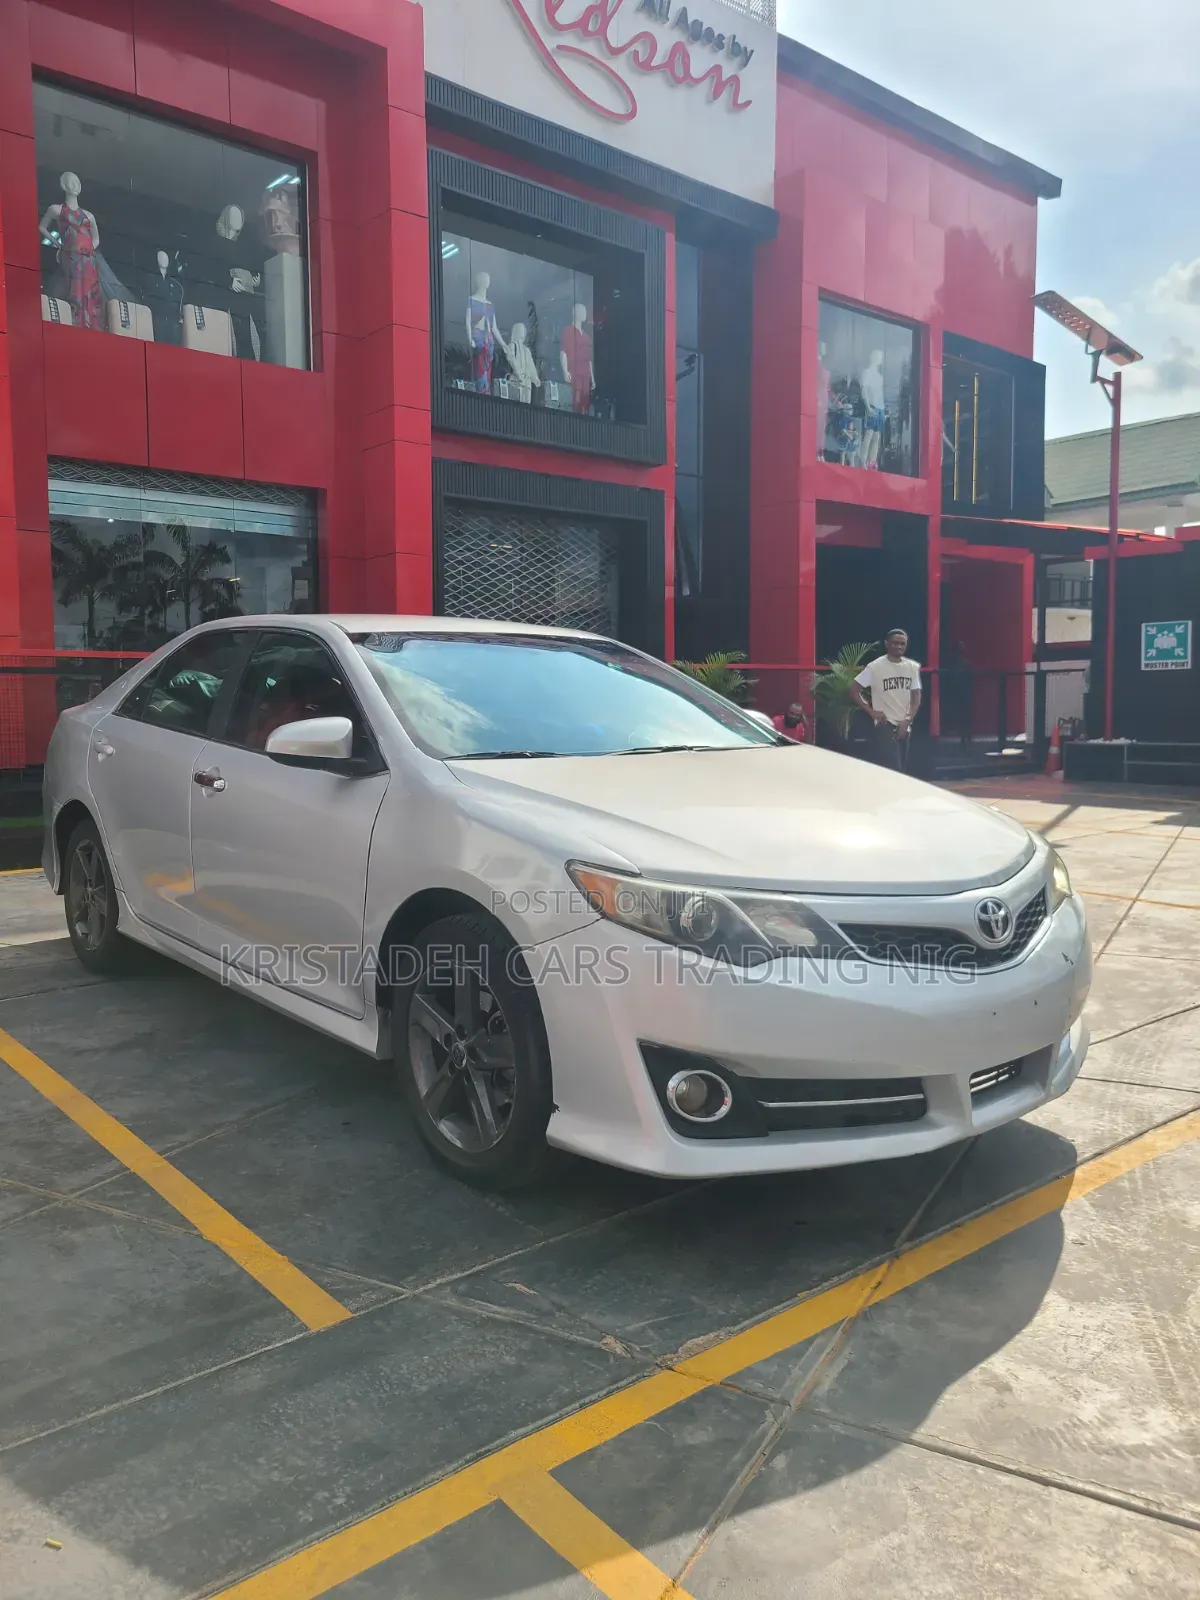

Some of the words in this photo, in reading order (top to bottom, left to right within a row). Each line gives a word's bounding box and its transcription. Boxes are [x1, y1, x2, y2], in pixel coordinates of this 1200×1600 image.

[511, 0, 752, 121] edson
[726, 34, 754, 70] by
[1170, 661, 1188, 669] POINT
